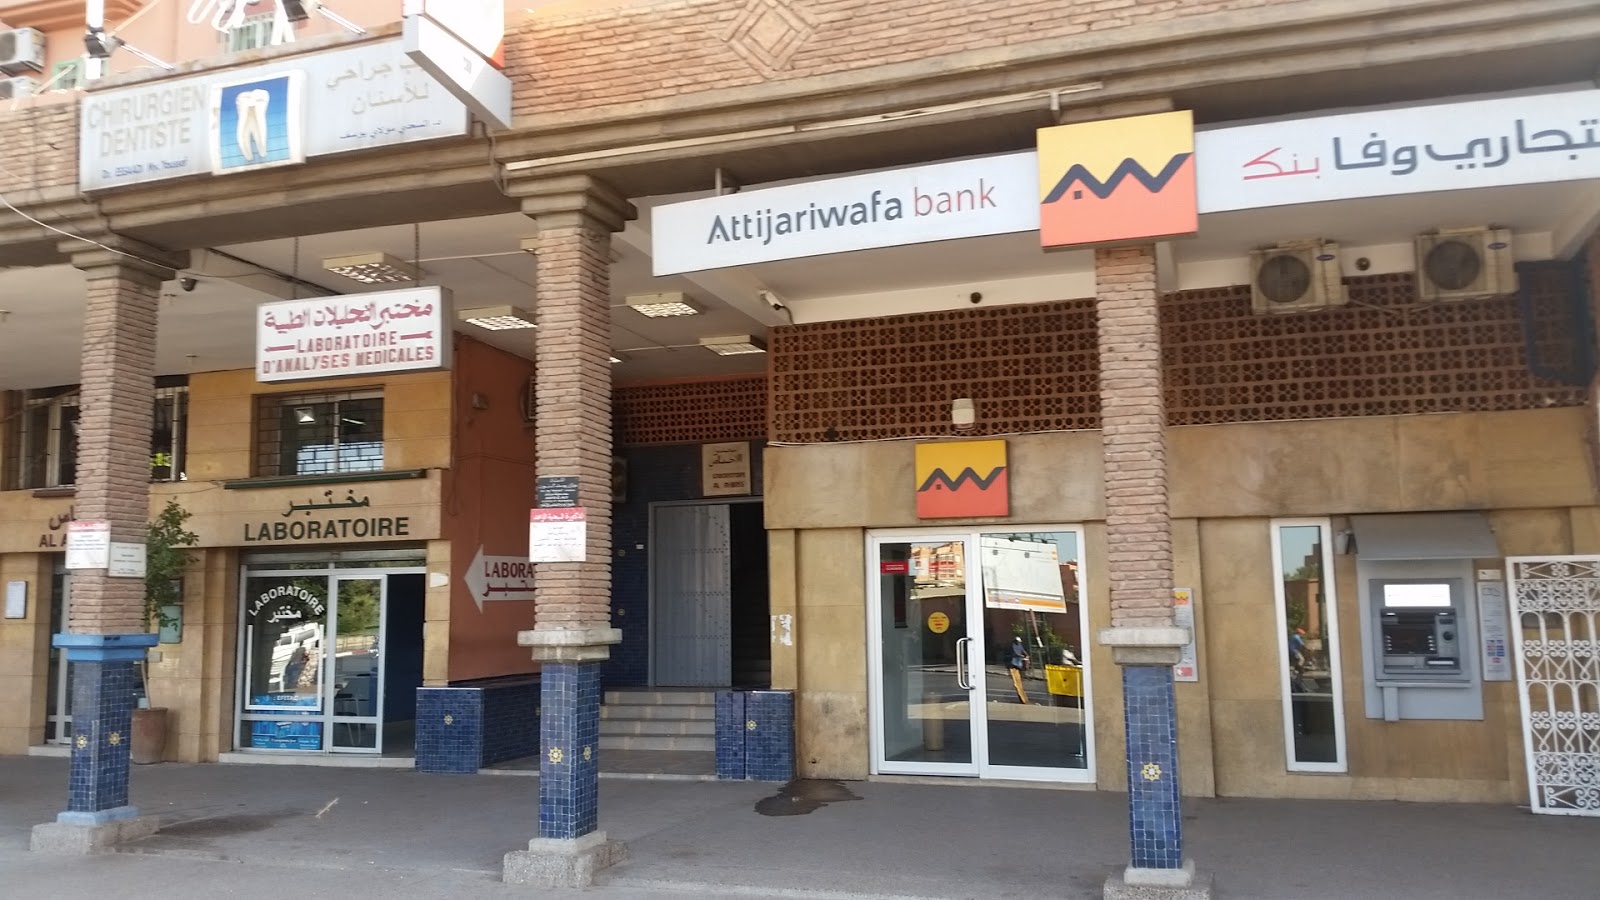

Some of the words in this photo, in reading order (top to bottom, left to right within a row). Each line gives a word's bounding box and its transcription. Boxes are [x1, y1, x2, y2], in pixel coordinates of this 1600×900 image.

[86, 84, 207, 129] CHIRURGIEN
[100, 117, 191, 157] DENTISTE
[1241, 146, 1321, 180] بنك
[1332, 132, 1418, 177] وفا
[706, 190, 903, 246] Attijariwafa
[913, 178, 997, 218] bank
[370, 299, 433, 330] مختبر
[297, 331, 398, 353] LABORATOIRE
[263, 353, 350, 374] D'ANALYSES
[355, 346, 434, 367] MEDICALES
[281, 489, 371, 518] مختبر
[38, 534, 57, 547] AL
[244, 517, 409, 542] LABORATOIRE
[484, 561, 537, 578] LABORA
[248, 584, 325, 617] LABORATOIRE
[267, 606, 302, 623] مختبر
